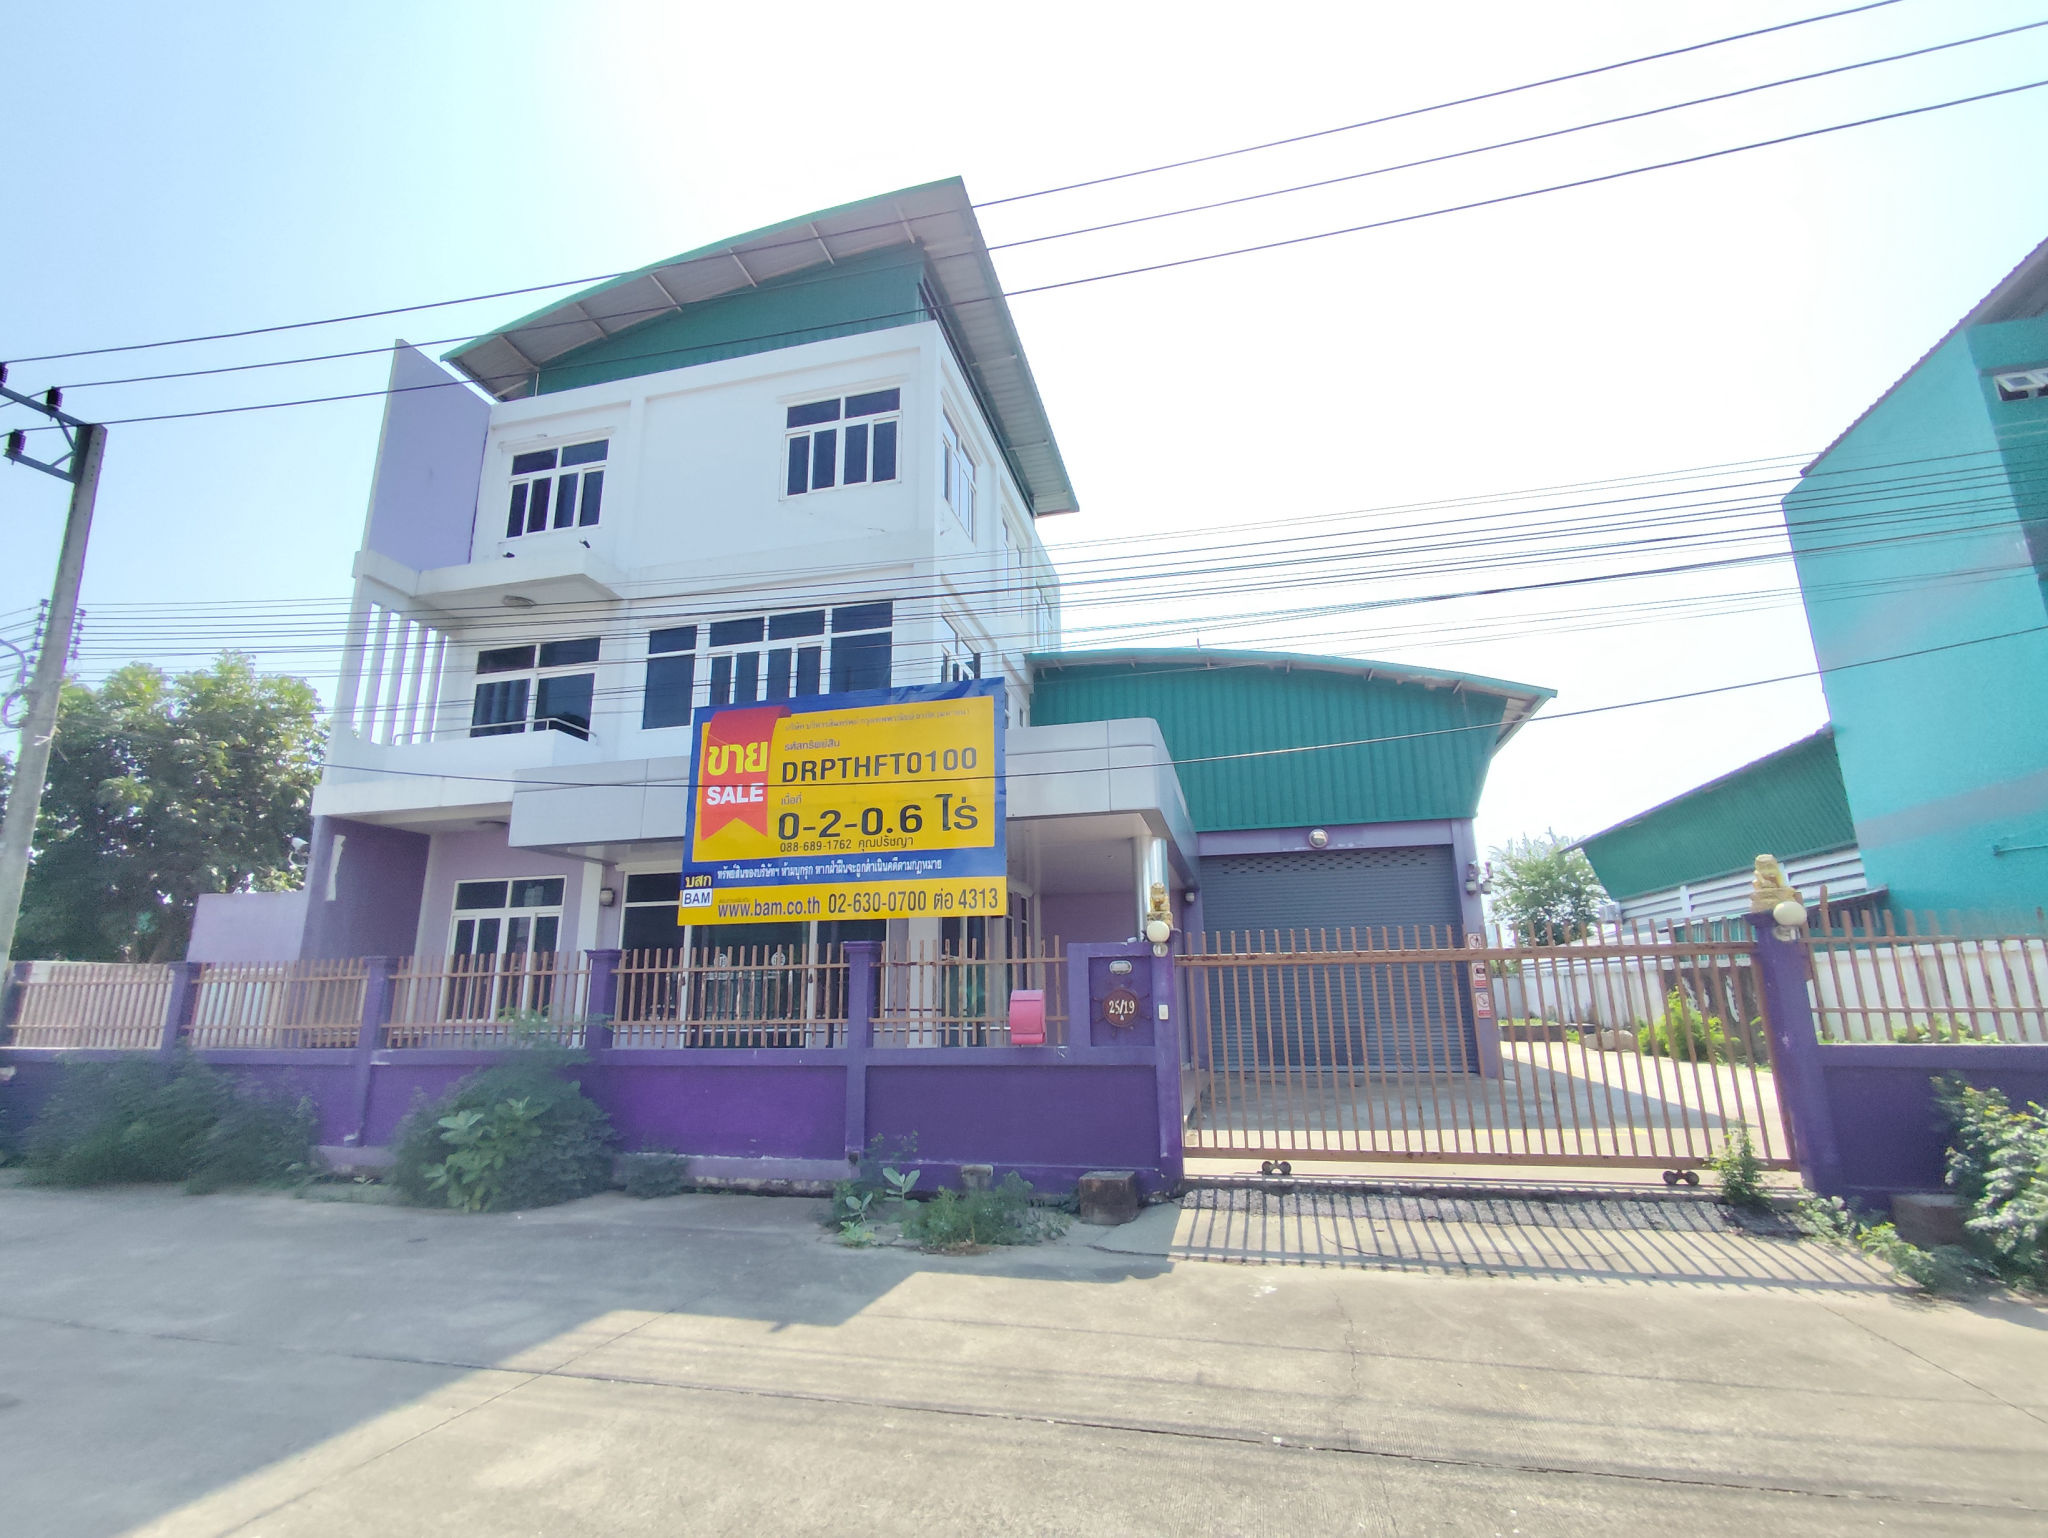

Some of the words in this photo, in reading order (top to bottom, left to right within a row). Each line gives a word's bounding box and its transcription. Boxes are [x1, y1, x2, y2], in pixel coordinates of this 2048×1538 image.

[784, 738, 840, 752] รหัสทรัพย์สิน
[707, 741, 767, 776] ขาย
[782, 747, 977, 783] DRPTHFT0100
[706, 783, 764, 806] SALE
[781, 792, 802, 806] เนื้อที่
[778, 804, 923, 840] 0-2-0.6
[934, 793, 979, 832] ไร่
[780, 839, 852, 853] 088-689-1762
[858, 834, 914, 852] คุณปรัชญา
[781, 862, 813, 880] ห้ามบุกรุก
[685, 874, 712, 888] บสก
[684, 892, 711, 905] BAM
[718, 896, 821, 918] www.bam.co.th
[828, 890, 927, 914] 02-630-0700
[934, 888, 954, 911] ต่อ
[958, 887, 998, 910] 4313
[1109, 999, 1135, 1015] 25/19
